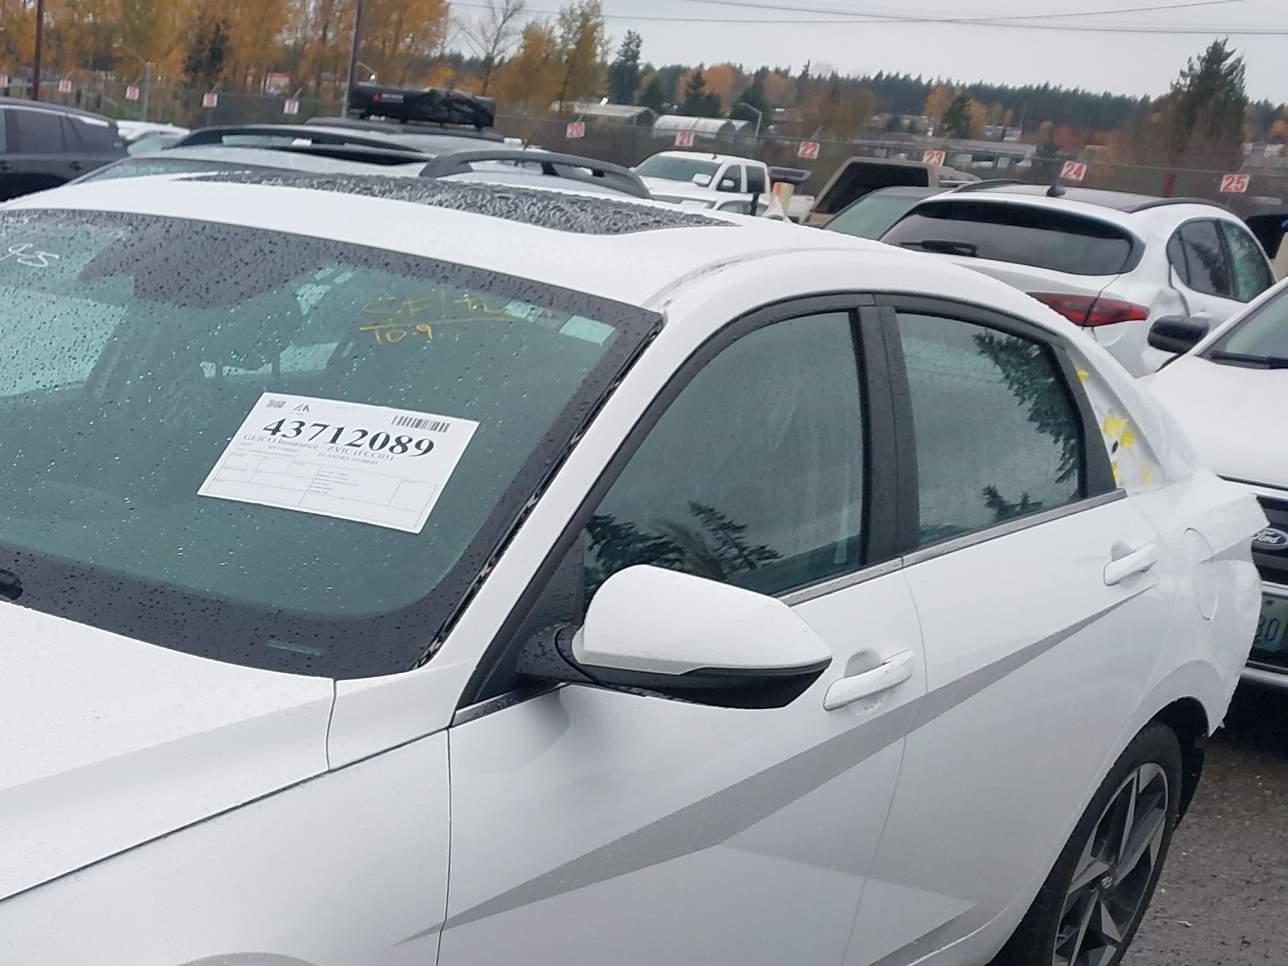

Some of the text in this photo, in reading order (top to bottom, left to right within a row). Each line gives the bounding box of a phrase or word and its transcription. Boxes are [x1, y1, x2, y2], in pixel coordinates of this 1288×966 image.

[678, 131, 690, 145] 21
[800, 142, 818, 157] 22
[923, 151, 942, 167] 23
[1063, 161, 1084, 178] 24
[1222, 175, 1246, 192] 25
[262, 418, 434, 457] 43712089
